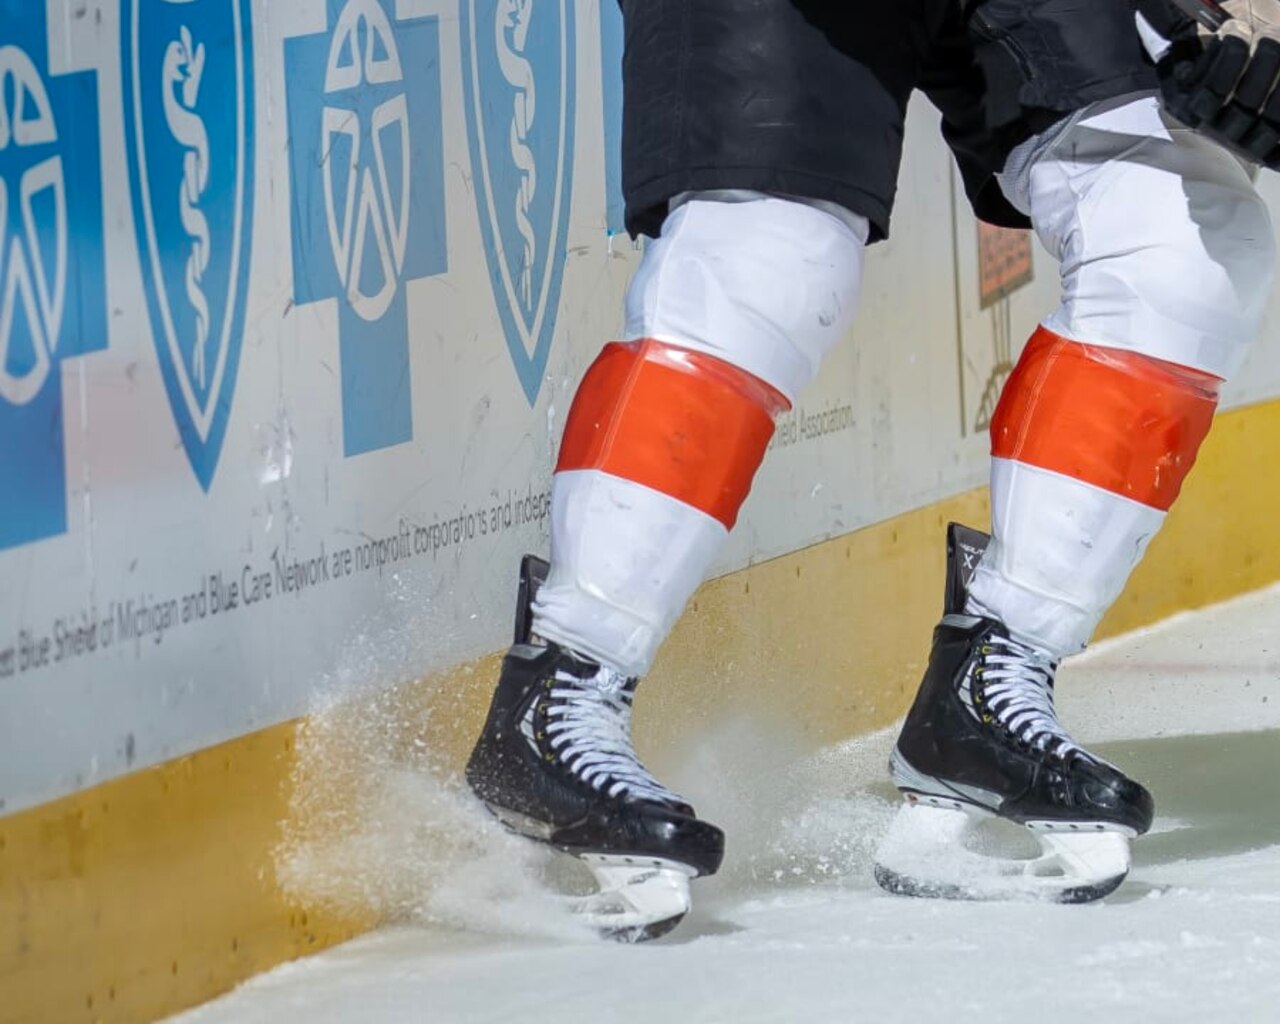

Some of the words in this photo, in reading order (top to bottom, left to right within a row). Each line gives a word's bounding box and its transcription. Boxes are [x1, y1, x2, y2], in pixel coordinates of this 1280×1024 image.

[18, 626, 50, 673] Blue
[53, 604, 97, 664] Shield
[100, 600, 115, 649] of
[116, 594, 178, 645] Michigan
[182, 575, 207, 624] and
[210, 568, 238, 616] Blue
[242, 563, 272, 606] Care
[274, 540, 330, 596] Network
[332, 548, 353, 579] are
[355, 519, 411, 578] nonprofit
[490, 488, 511, 528] and
